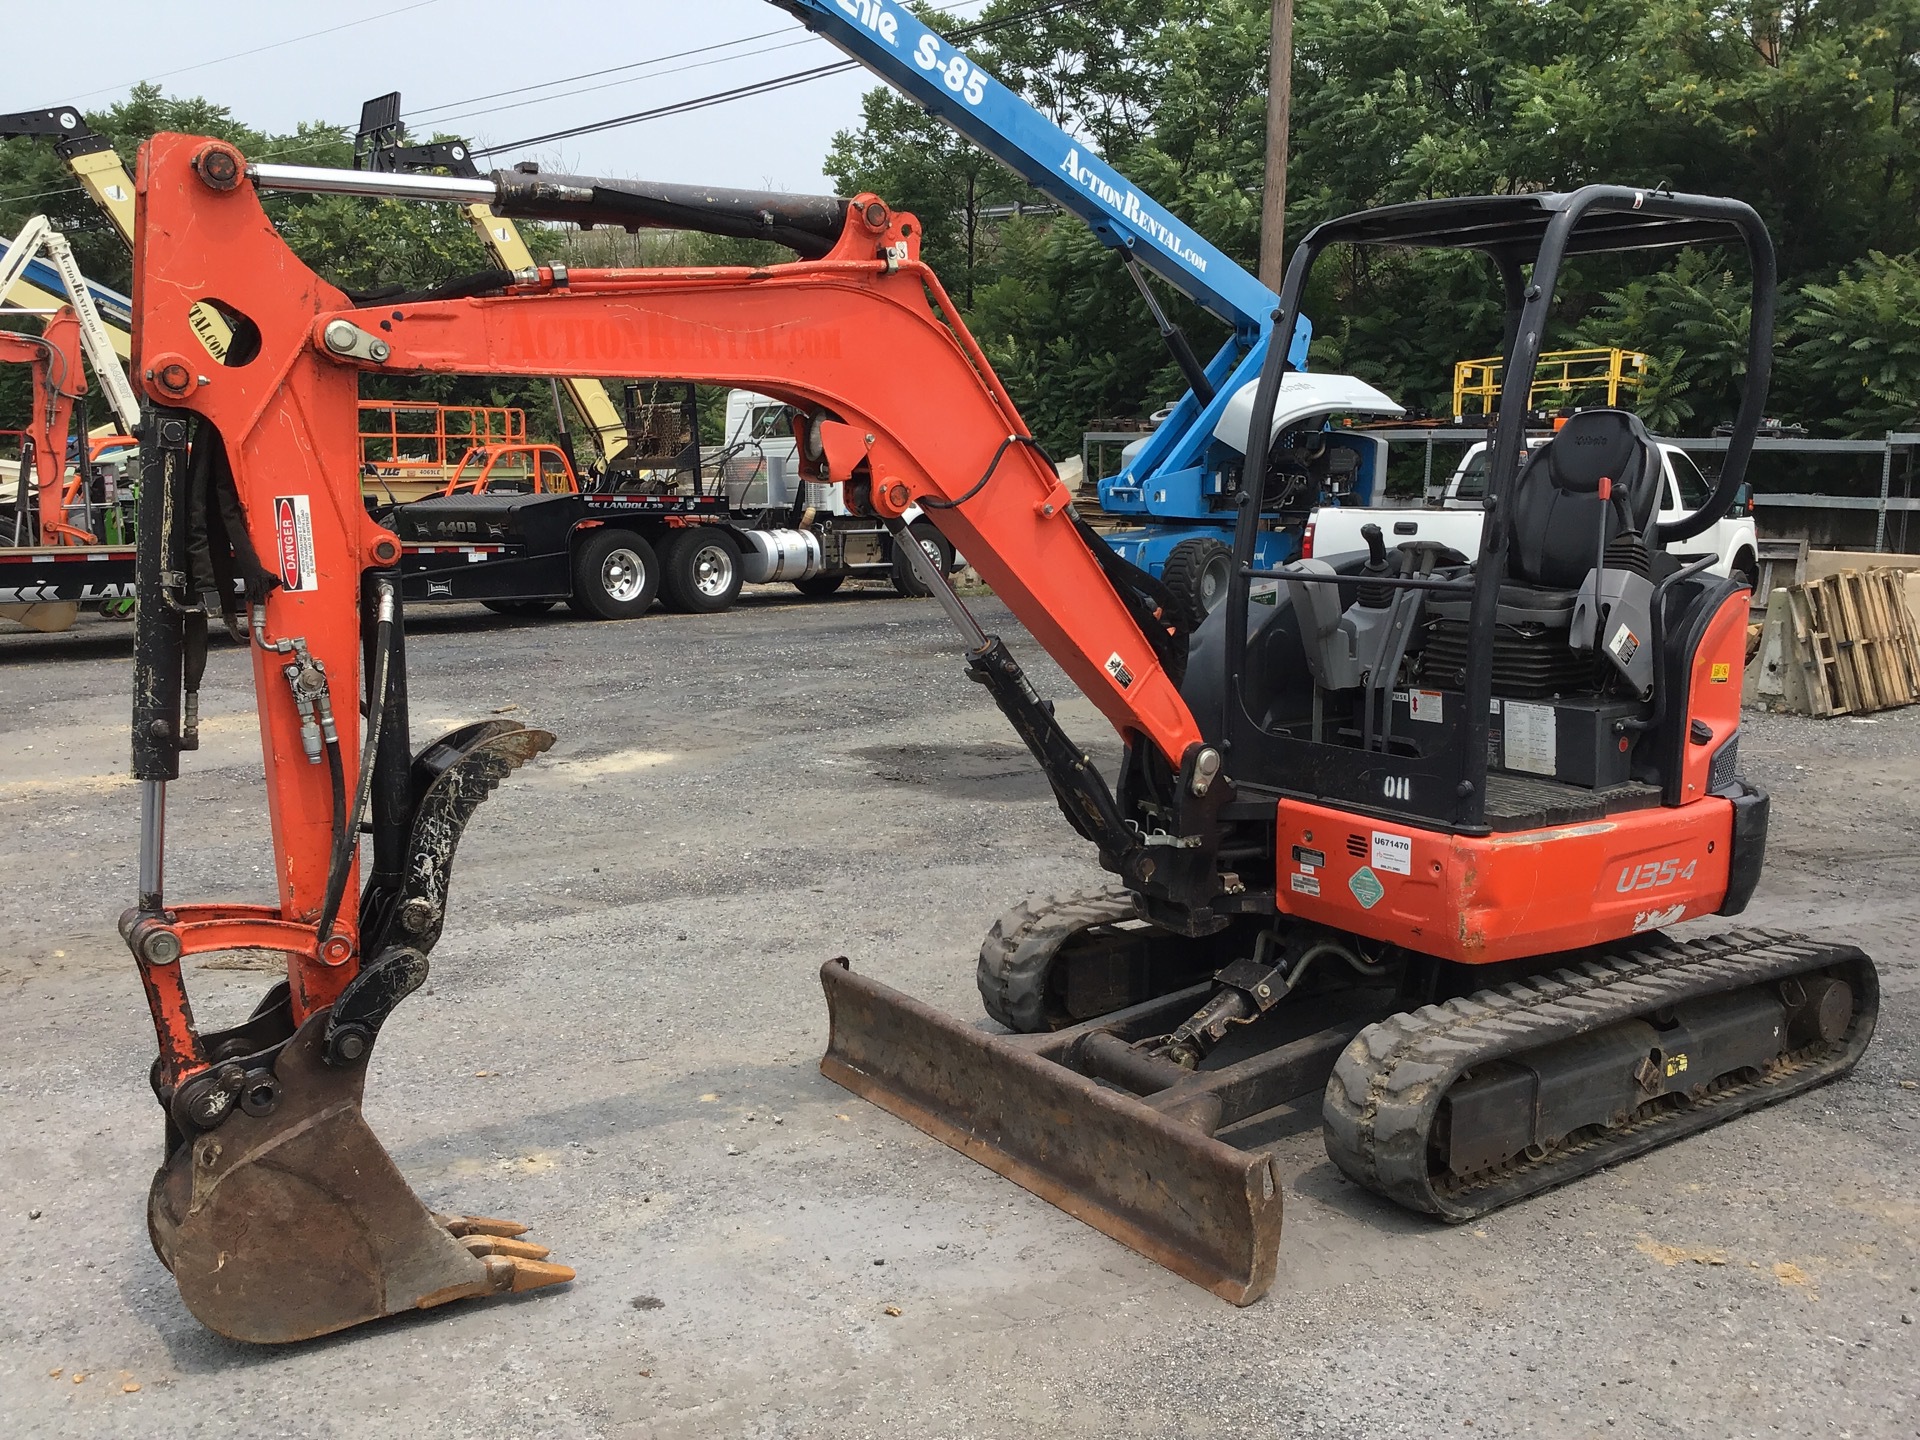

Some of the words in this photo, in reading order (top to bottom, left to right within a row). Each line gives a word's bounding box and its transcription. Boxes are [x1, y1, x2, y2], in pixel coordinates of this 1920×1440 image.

[913, 34, 988, 105] S-85
[381, 467, 401, 476] JLG
[437, 521, 477, 533] 440B
[283, 519, 296, 570] DANGER
[1374, 837, 1409, 851] U671470
[1616, 858, 1697, 893] U35-4
